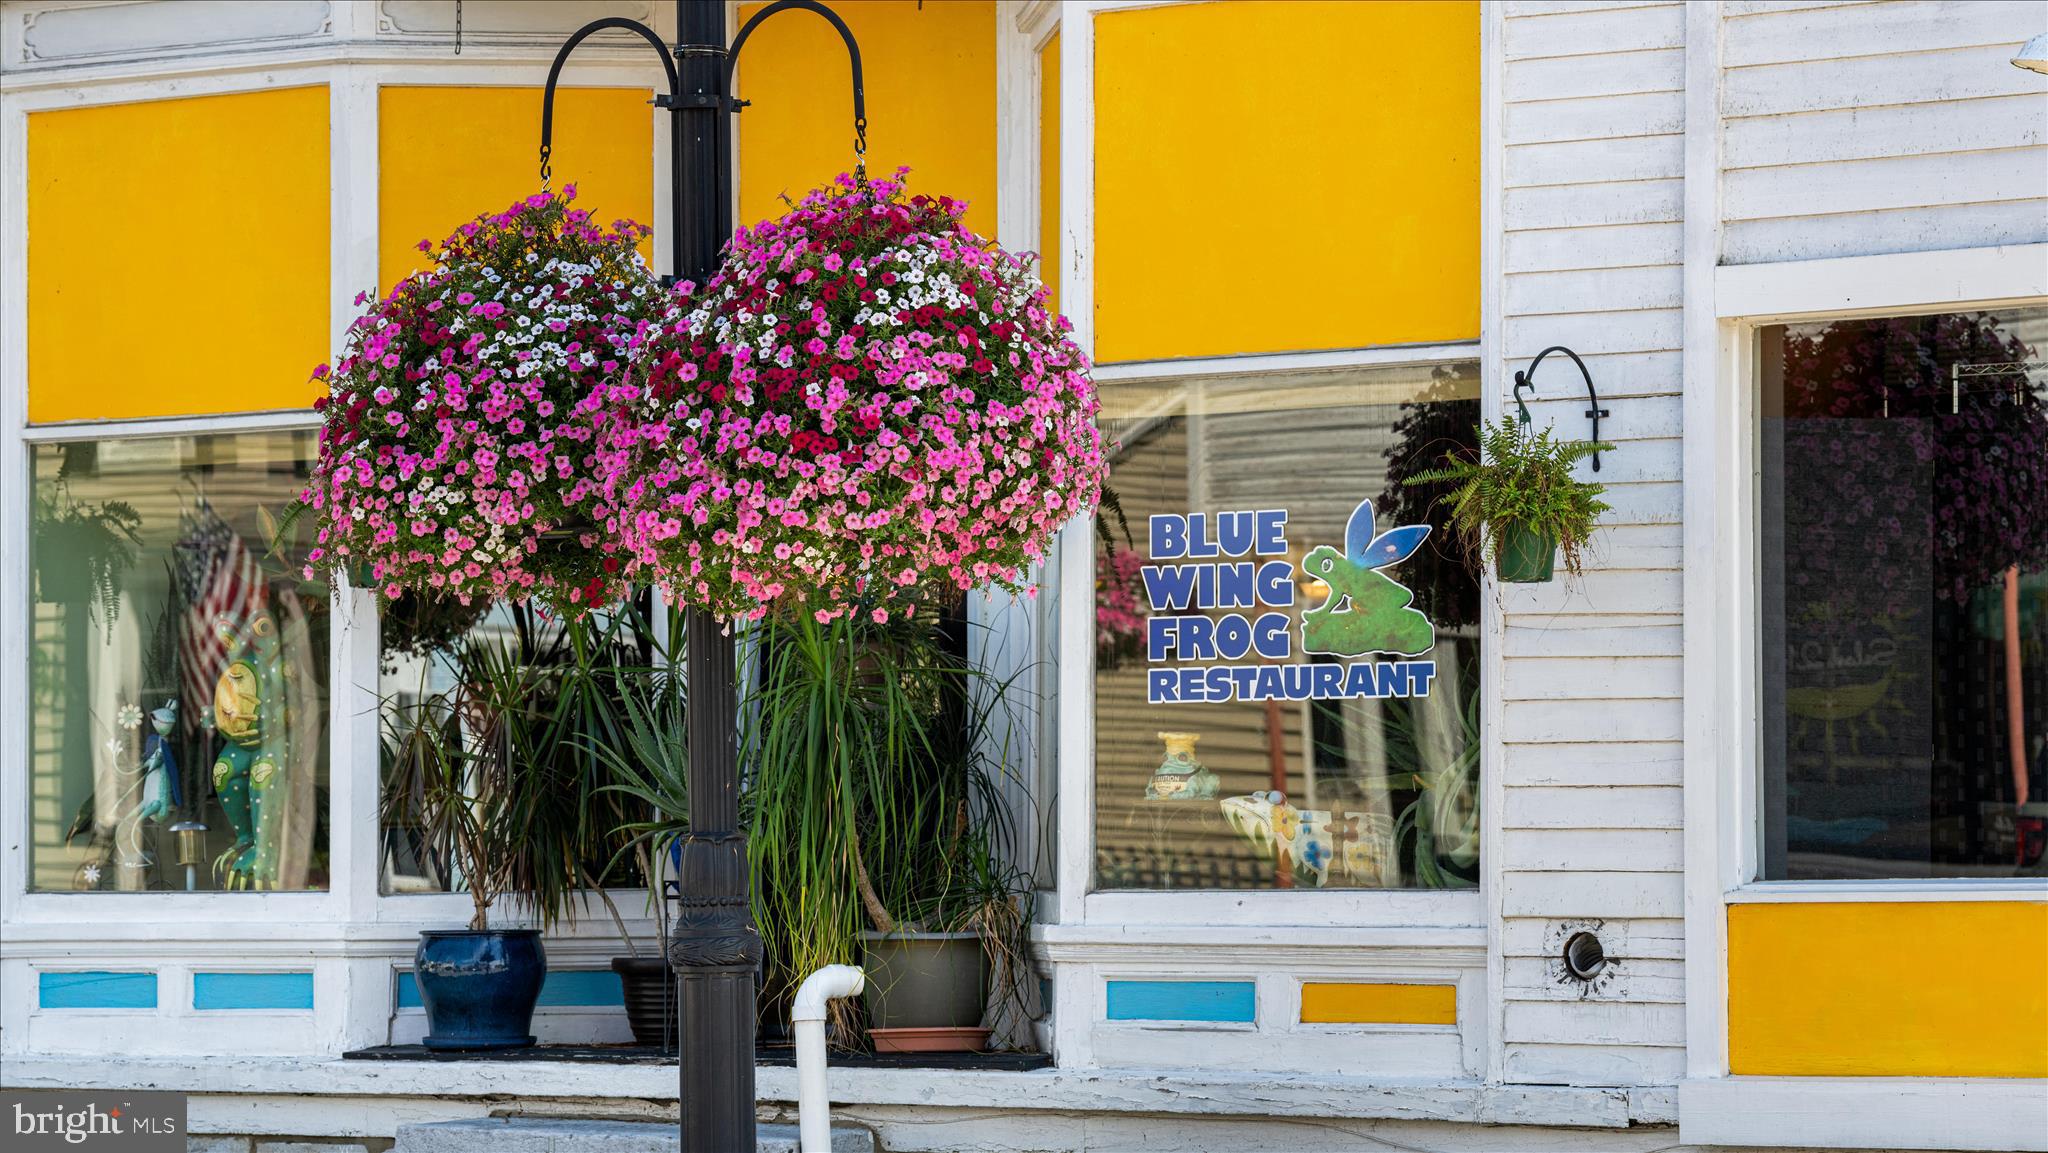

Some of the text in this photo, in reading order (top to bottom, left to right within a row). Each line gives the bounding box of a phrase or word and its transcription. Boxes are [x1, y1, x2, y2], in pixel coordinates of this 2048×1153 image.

[1149, 509, 1288, 560] BLUE
[1140, 560, 1295, 611] WING
[1147, 612, 1291, 662] FROG
[1147, 661, 1436, 704] RESTAURANT
